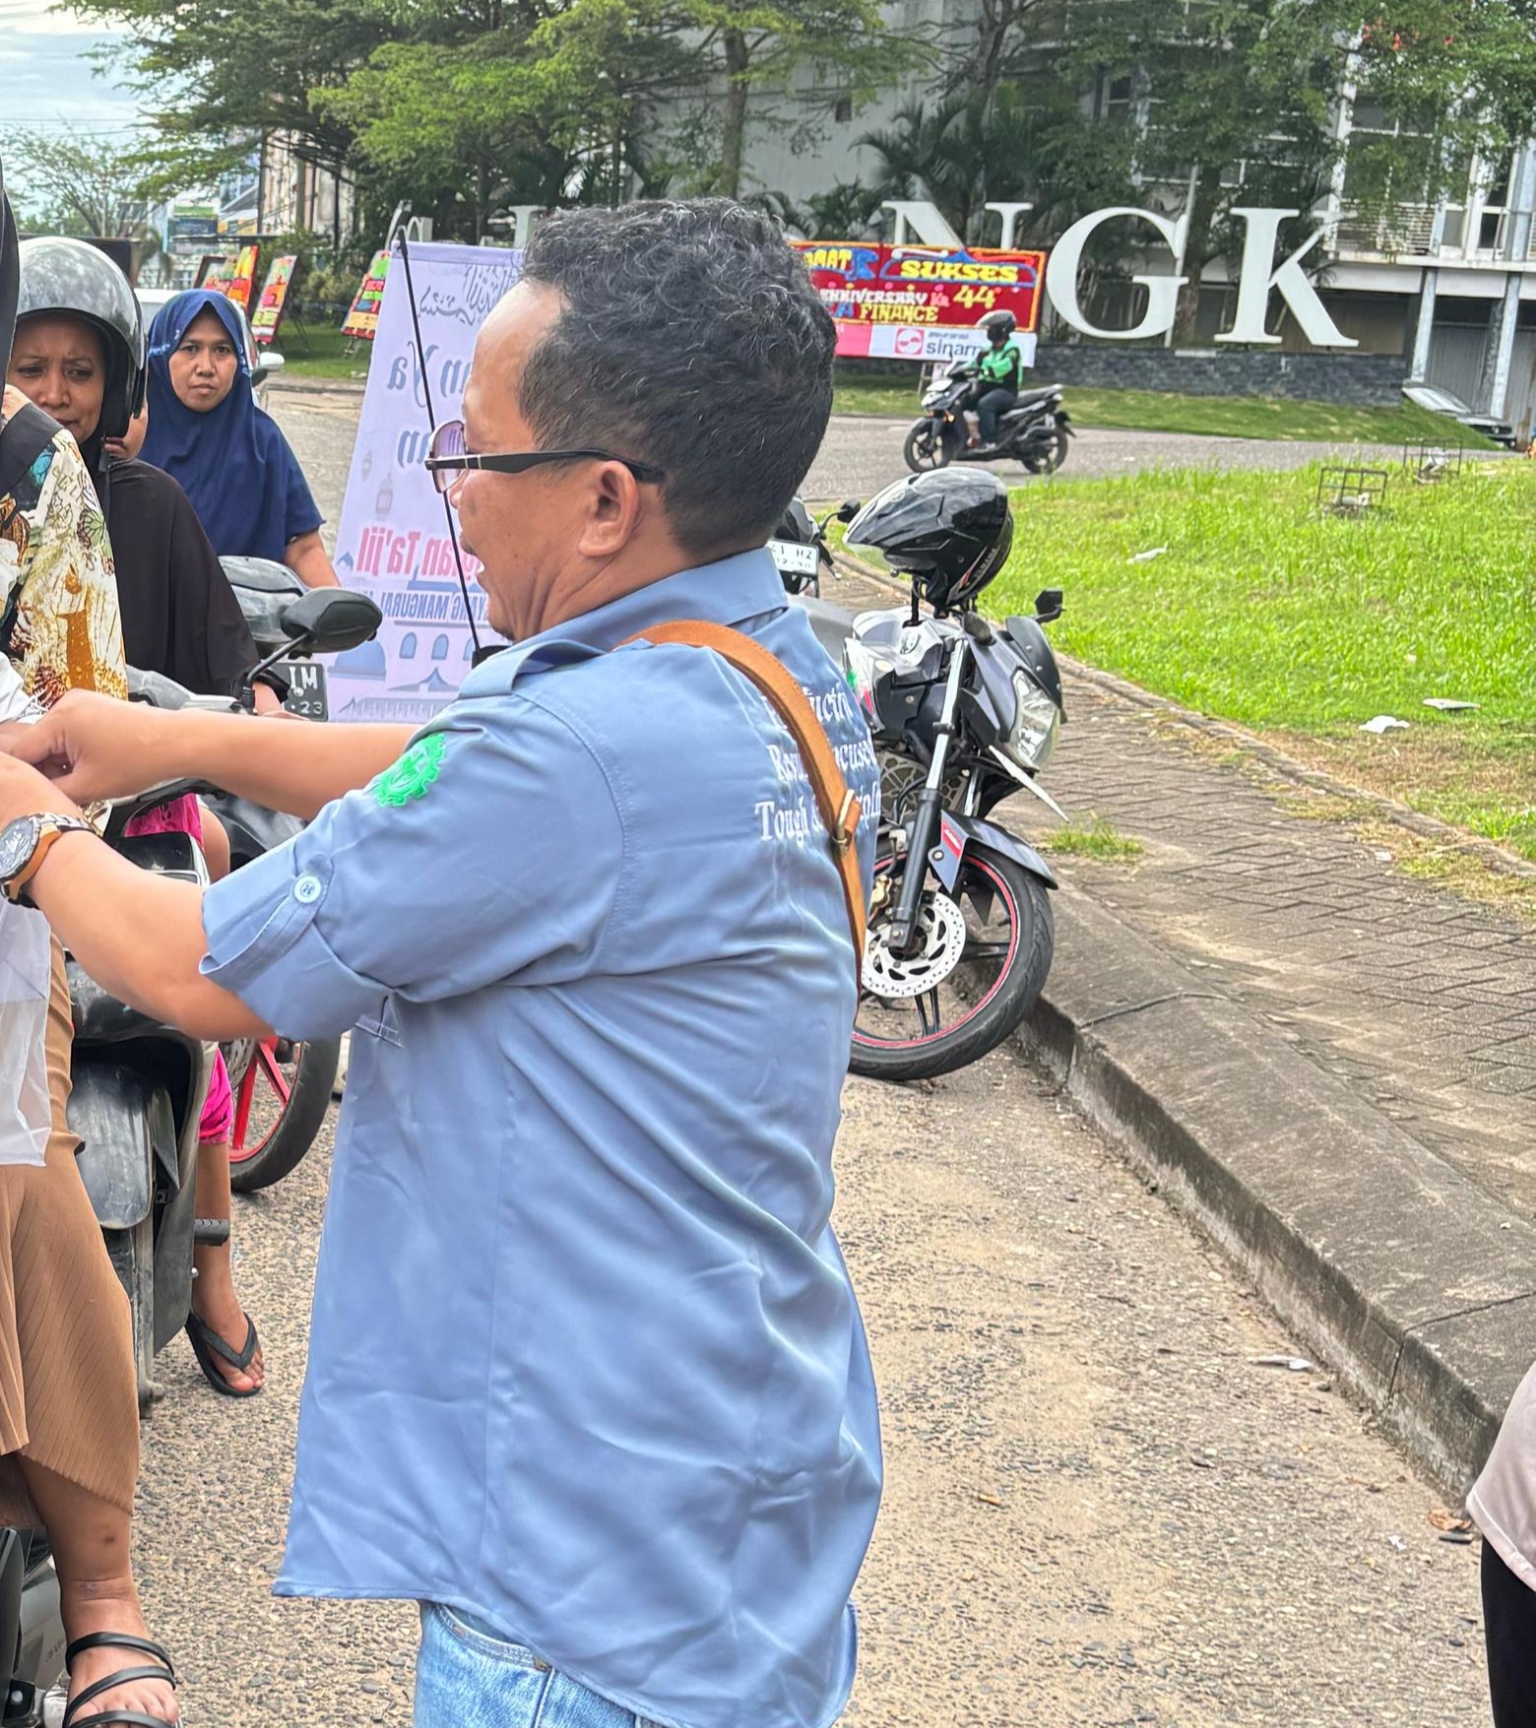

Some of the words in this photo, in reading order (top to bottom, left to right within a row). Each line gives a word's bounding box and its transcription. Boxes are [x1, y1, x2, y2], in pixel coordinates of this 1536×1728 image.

[900, 260, 1019, 283] SUKSES
[953, 285, 996, 309] 44
[859, 304, 939, 322] FINANCE
[755, 796, 810, 848] Tough
